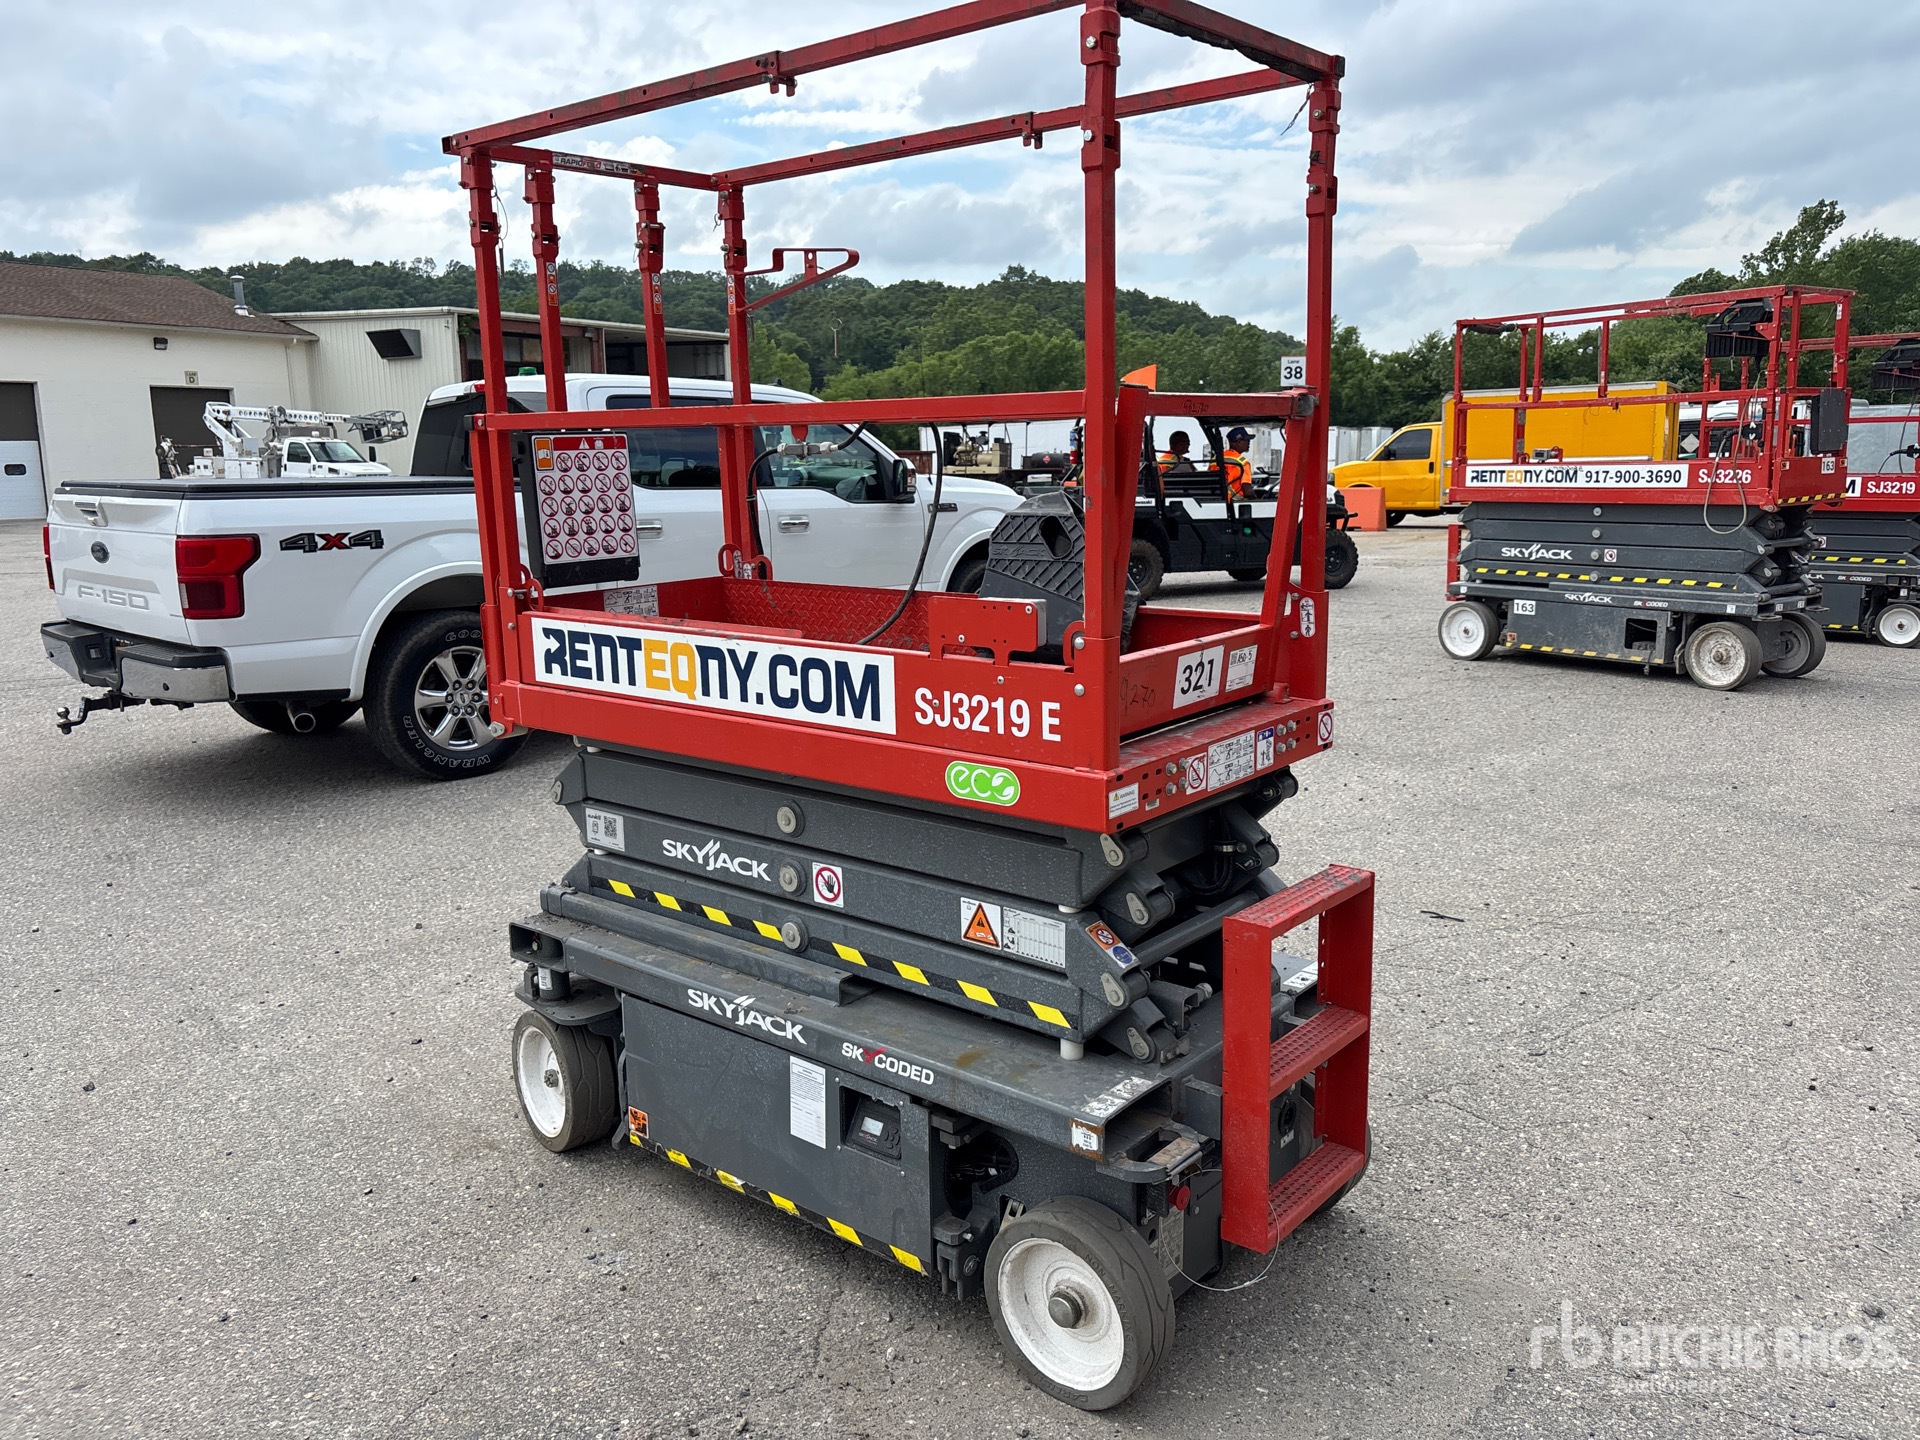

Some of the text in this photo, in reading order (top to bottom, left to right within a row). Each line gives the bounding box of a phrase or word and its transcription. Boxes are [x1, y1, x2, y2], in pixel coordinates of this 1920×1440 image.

[188, 376, 196, 384] D
[1283, 366, 1303, 380] 38
[1471, 469, 1578, 484] RENTEQNY.COM
[1585, 470, 1682, 484] 917-900-3690
[1822, 460, 1835, 471] 163
[1866, 481, 1916, 494] SJ3219
[1501, 543, 1573, 561] SKYJACK
[77, 584, 150, 611] F-150
[1514, 602, 1535, 613] 163
[1564, 592, 1613, 604] SKYJACK
[542, 627, 881, 722] RENTEQNY.COM
[1180, 658, 1215, 695] 321
[915, 687, 1062, 742] SJ3219 E
[403, 715, 491, 768] WRANGLER
[948, 764, 1016, 802] eco
[662, 838, 771, 882] SKYJACK
[687, 988, 807, 1045] SKYJACK
[841, 1042, 935, 1085] SKYCODED
